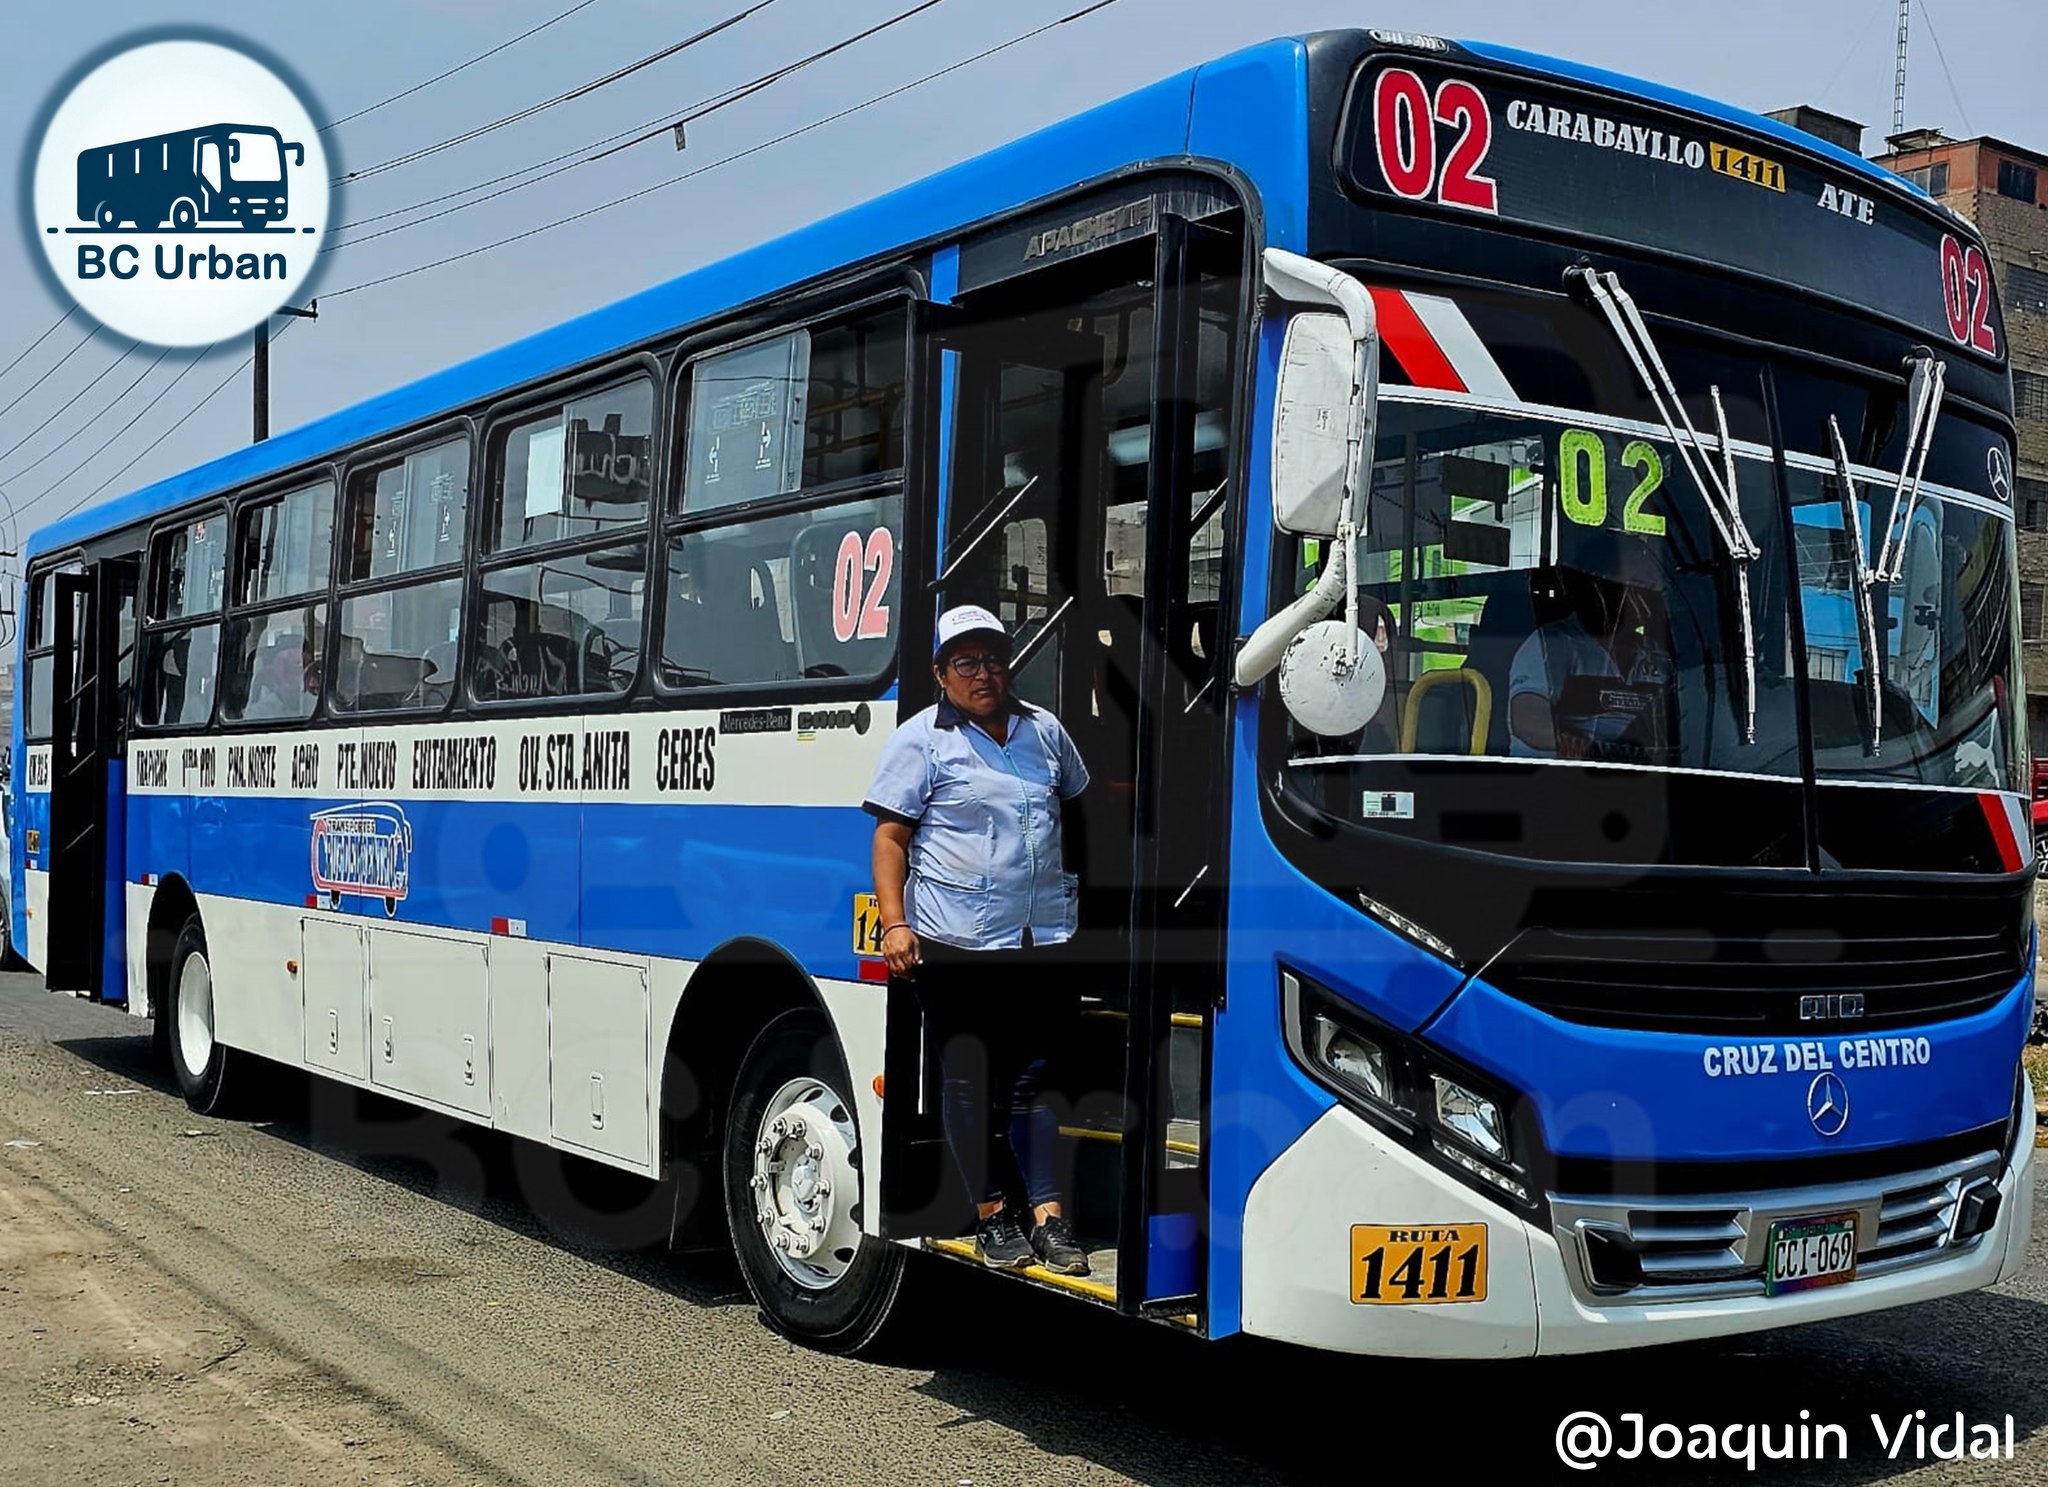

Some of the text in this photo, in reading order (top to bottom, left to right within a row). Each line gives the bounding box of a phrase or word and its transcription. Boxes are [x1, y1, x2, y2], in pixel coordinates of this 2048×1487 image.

[1373, 68, 1499, 216] 02
[1507, 98, 1876, 226] CARABAYLLO 1411 ATE
[1940, 233, 1997, 357] 02
[1559, 428, 1668, 536] 02
[832, 526, 894, 644] 02
[721, 711, 790, 733] Mercedes-Benz
[412, 735, 497, 791] EVITAMIENTO
[656, 726, 716, 792] CERES
[326, 820, 375, 834] TRANSPORTES
[1703, 1036, 1931, 1077] CRUZ DEL CENTRO
[1388, 1229, 1461, 1243] RUTA
[1775, 1232, 1852, 1279] CCI-069
[1360, 1244, 1479, 1299] 1411
